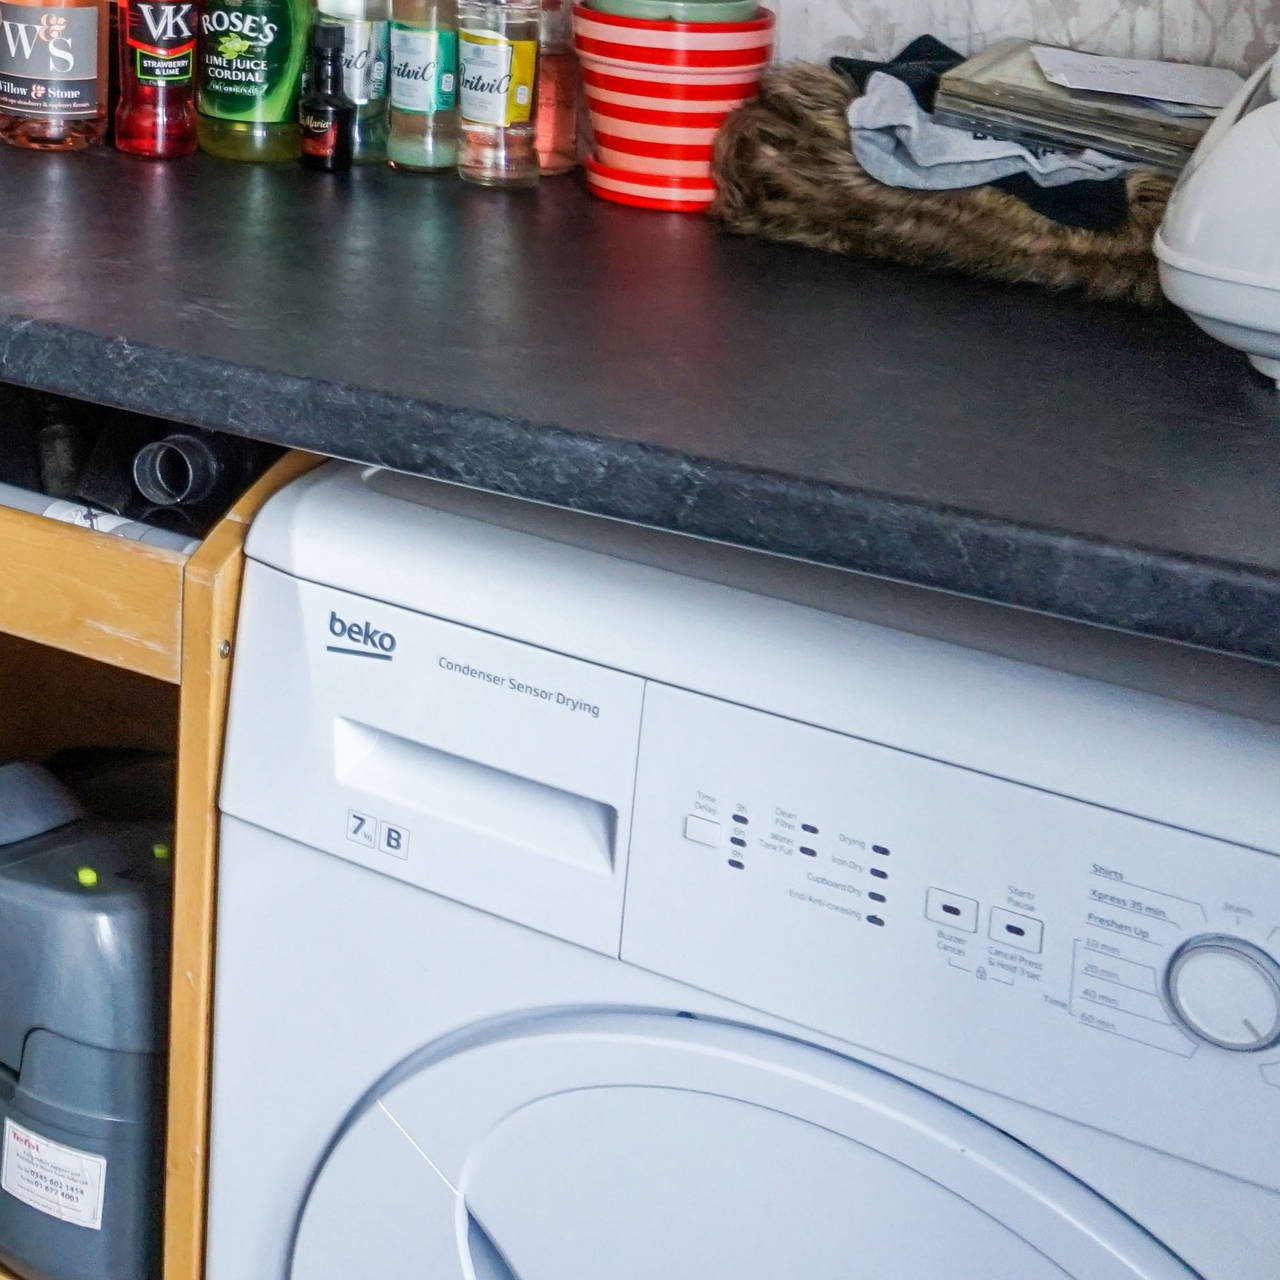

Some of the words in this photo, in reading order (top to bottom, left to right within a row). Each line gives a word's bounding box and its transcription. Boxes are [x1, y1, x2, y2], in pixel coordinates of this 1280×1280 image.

[137, 3, 193, 42] VK
[202, 10, 278, 47] ROSE'S
[143, 59, 189, 68] STRAWBERRY
[205, 54, 229, 68] LIME
[232, 57, 268, 70] JUICE
[208, 67, 264, 83] CORDIAL
[30, 84, 46, 100] &
[48, 87, 81, 99] Stone
[328, 611, 396, 652] beko
[438, 656, 506, 686] Condenser
[508, 677, 553, 702] Sensor
[556, 692, 600, 718] Drying
[352, 814, 366, 834] 7
[386, 827, 402, 850] B
[839, 833, 865, 850] Drying
[1092, 863, 1124, 881] Shirts
[1090, 888, 1127, 907] Xpress
[1088, 912, 1132, 934] Freshen
[1134, 927, 1150, 940] Up
